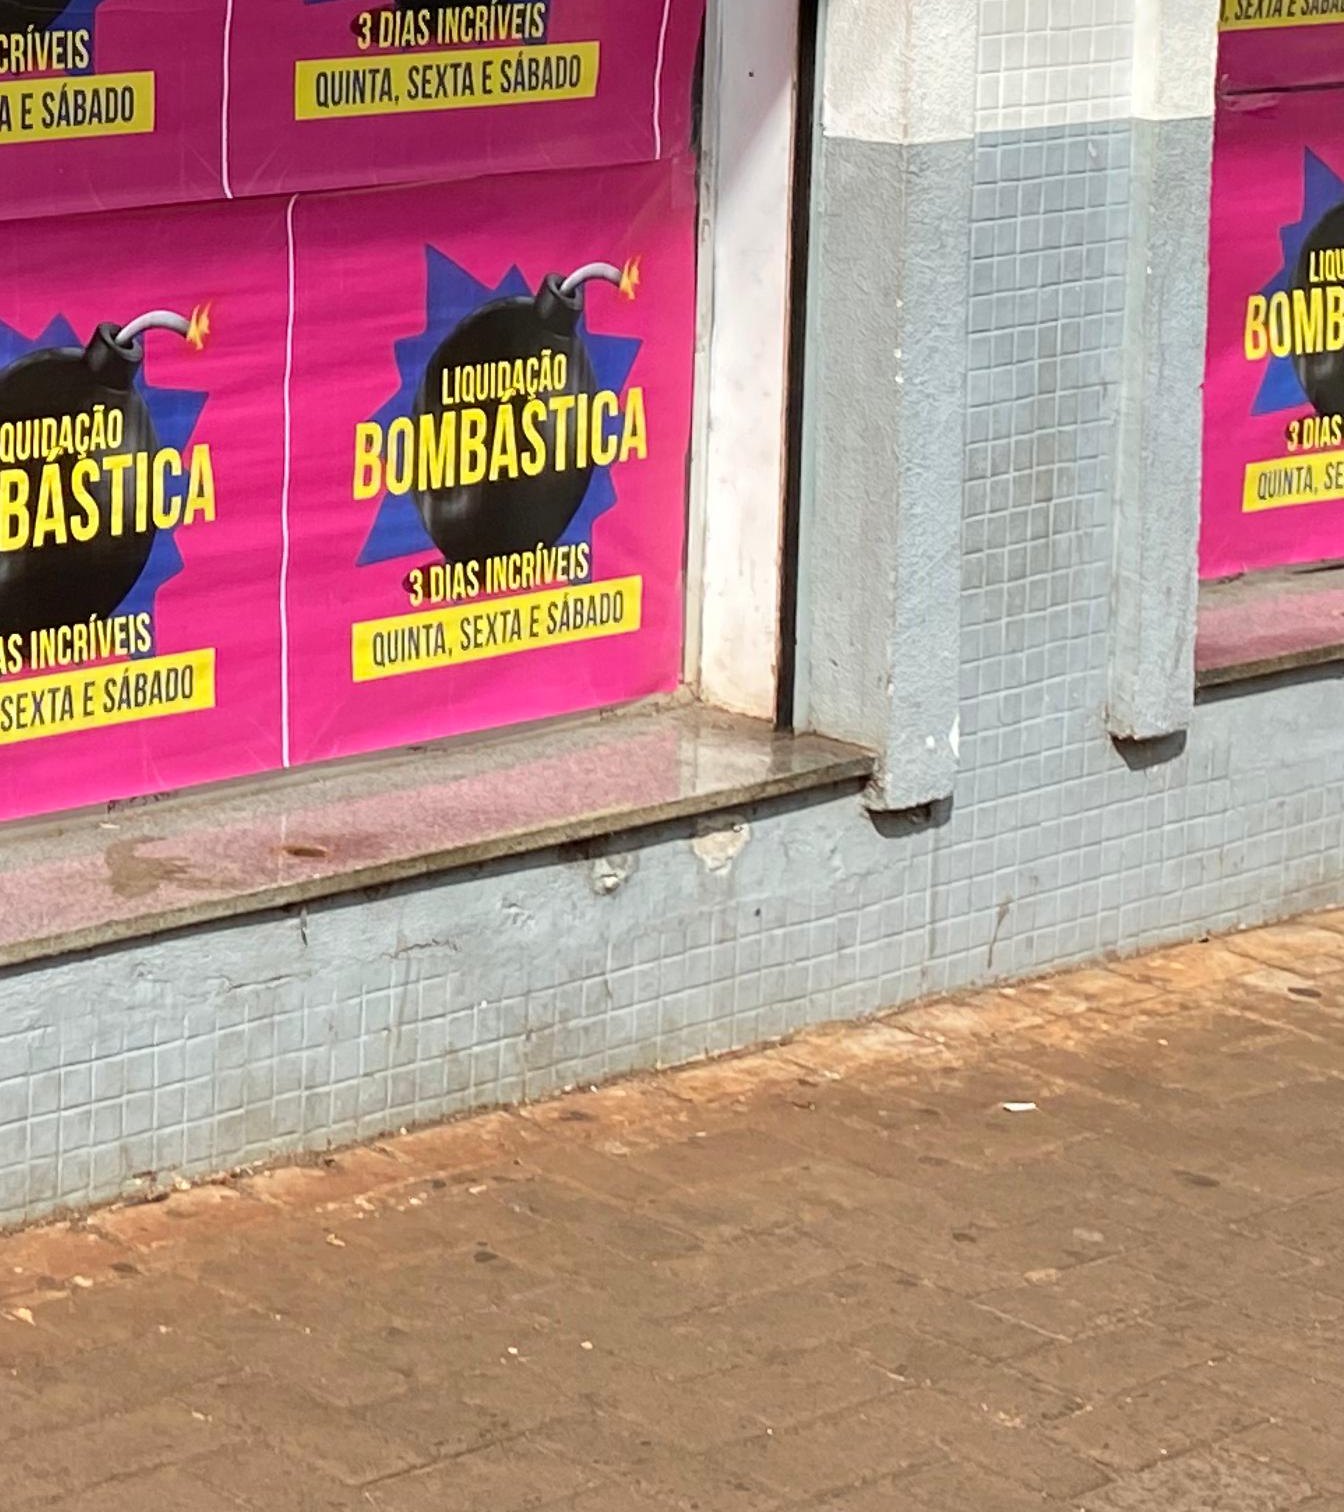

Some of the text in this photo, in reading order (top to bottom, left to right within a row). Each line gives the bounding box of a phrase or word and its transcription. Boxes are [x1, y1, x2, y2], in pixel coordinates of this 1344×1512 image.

[357, 13, 371, 49] 3
[379, 8, 430, 48] DIAS
[21, 93, 33, 129] E
[42, 84, 134, 127] SÁBADO
[316, 51, 581, 107] QUINTA, SEXTA E SÁBADO
[442, 348, 567, 405] LIQUIDAÇÃO
[353, 387, 647, 501] BOMBÁSTICA
[1288, 415, 1342, 451] 3 DIAS
[1258, 465, 1317, 500] QUINTA,
[409, 542, 589, 607] 3 DIAS INCRÍVEIS
[32, 613, 151, 670] INCRÍVEIS
[373, 590, 623, 667] QUINTA, SEXTA E SÁBADO
[0, 685, 73, 732] SEXTA
[83, 681, 95, 717] E
[103, 664, 194, 713] SÁBADO
